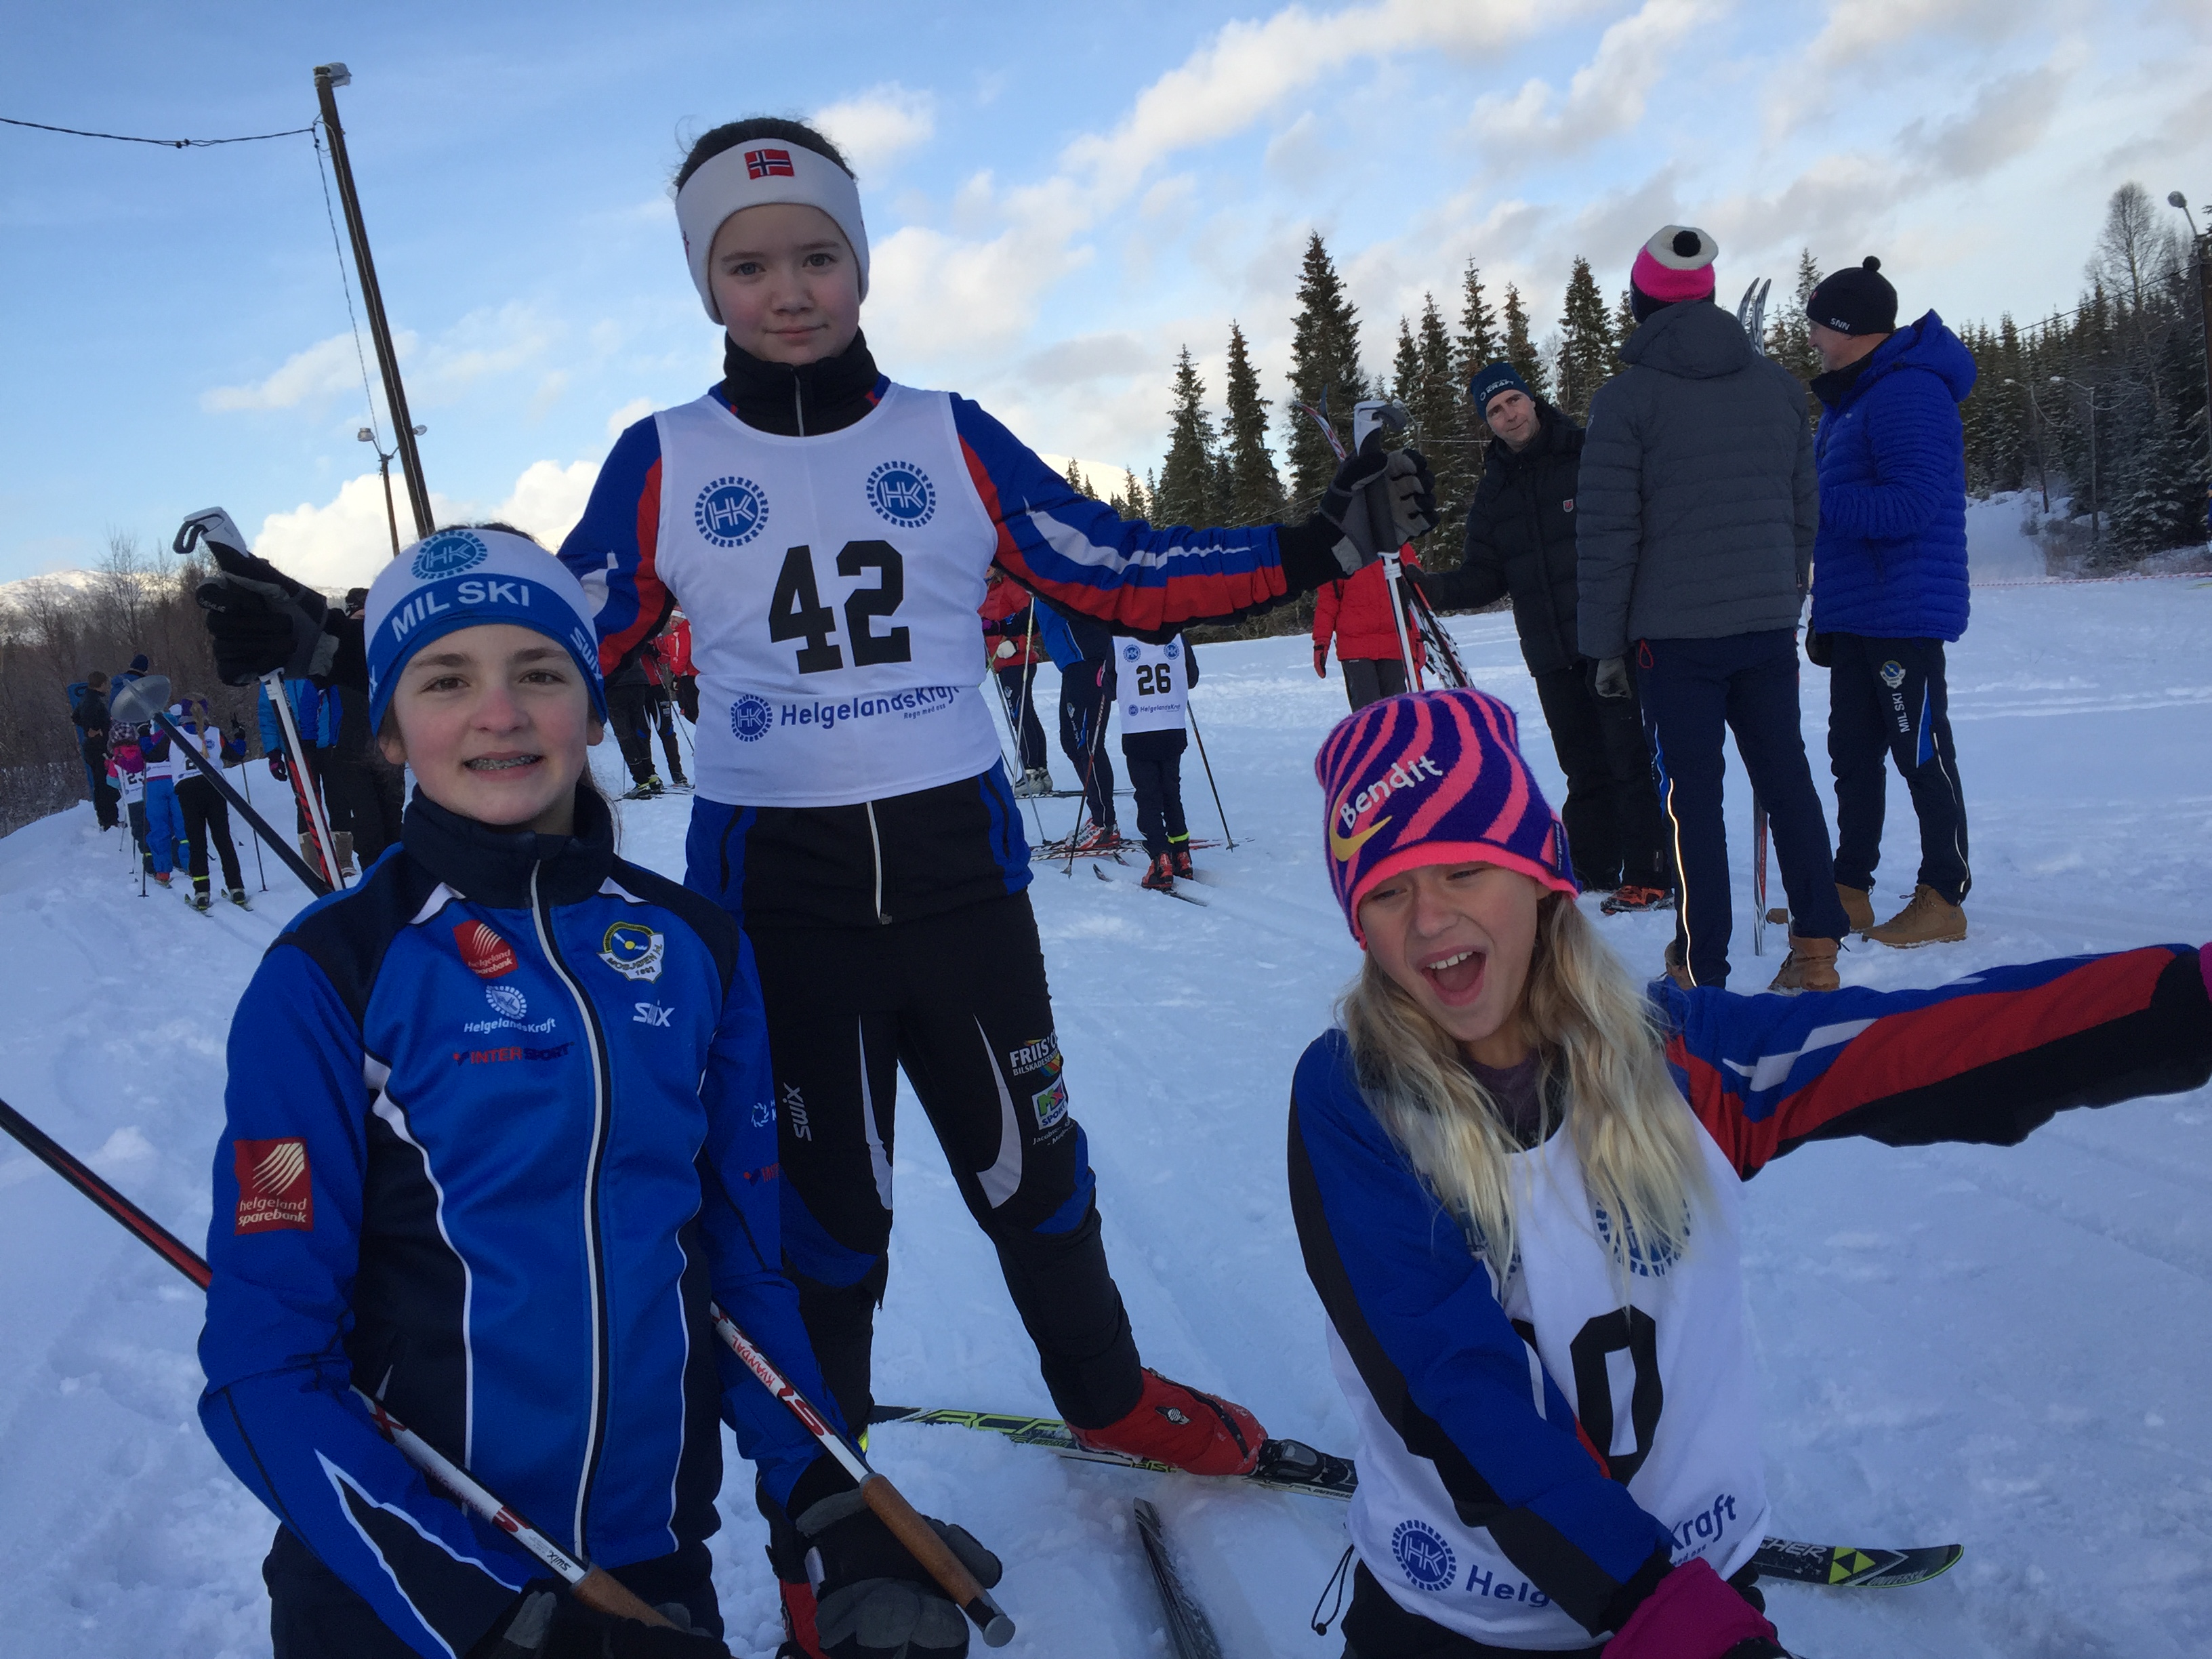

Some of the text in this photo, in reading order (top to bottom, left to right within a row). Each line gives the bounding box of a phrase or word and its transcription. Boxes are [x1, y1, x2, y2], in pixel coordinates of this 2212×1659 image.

[391, 581, 530, 642] MIL SKI
[768, 539, 912, 675] 42
[1136, 663, 1171, 697] 26
[1897, 712, 1911, 733] MIL
[1339, 755, 1443, 830] Bendit
[464, 1017, 557, 1034] HelgelandsKraft
[238, 1208, 307, 1227] sparebank
[239, 1196, 308, 1212] helgeland
[732, 1334, 776, 1387] KVANDAL
